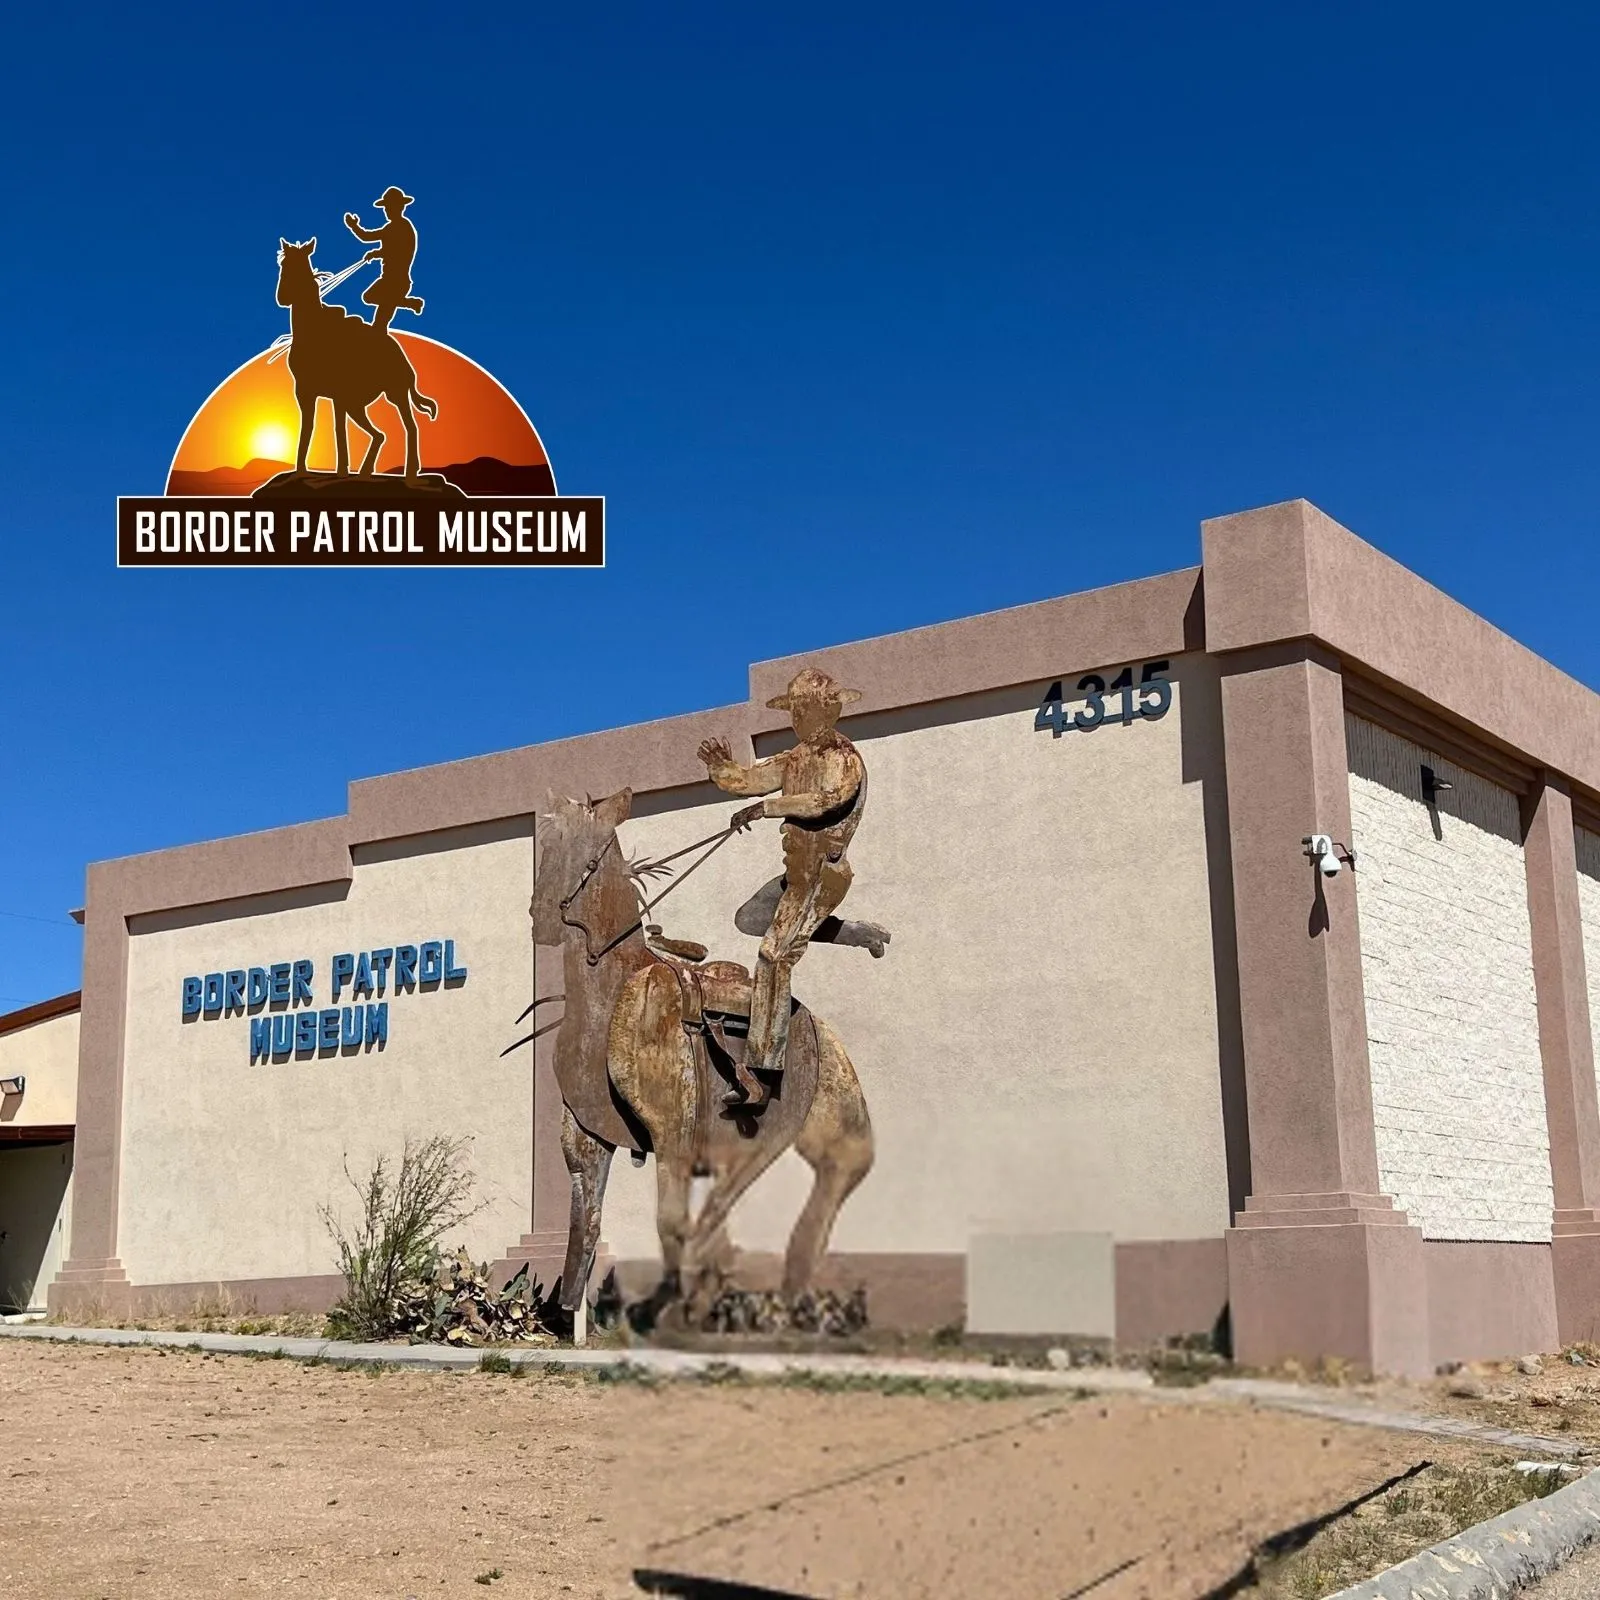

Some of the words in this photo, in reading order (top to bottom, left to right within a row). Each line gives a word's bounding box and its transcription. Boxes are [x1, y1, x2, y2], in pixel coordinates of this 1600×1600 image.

[1034, 660, 1173, 735] 4315
[182, 959, 314, 1017] BORDER
[331, 939, 468, 998] PATROL
[250, 1002, 389, 1059] MUSEUM
